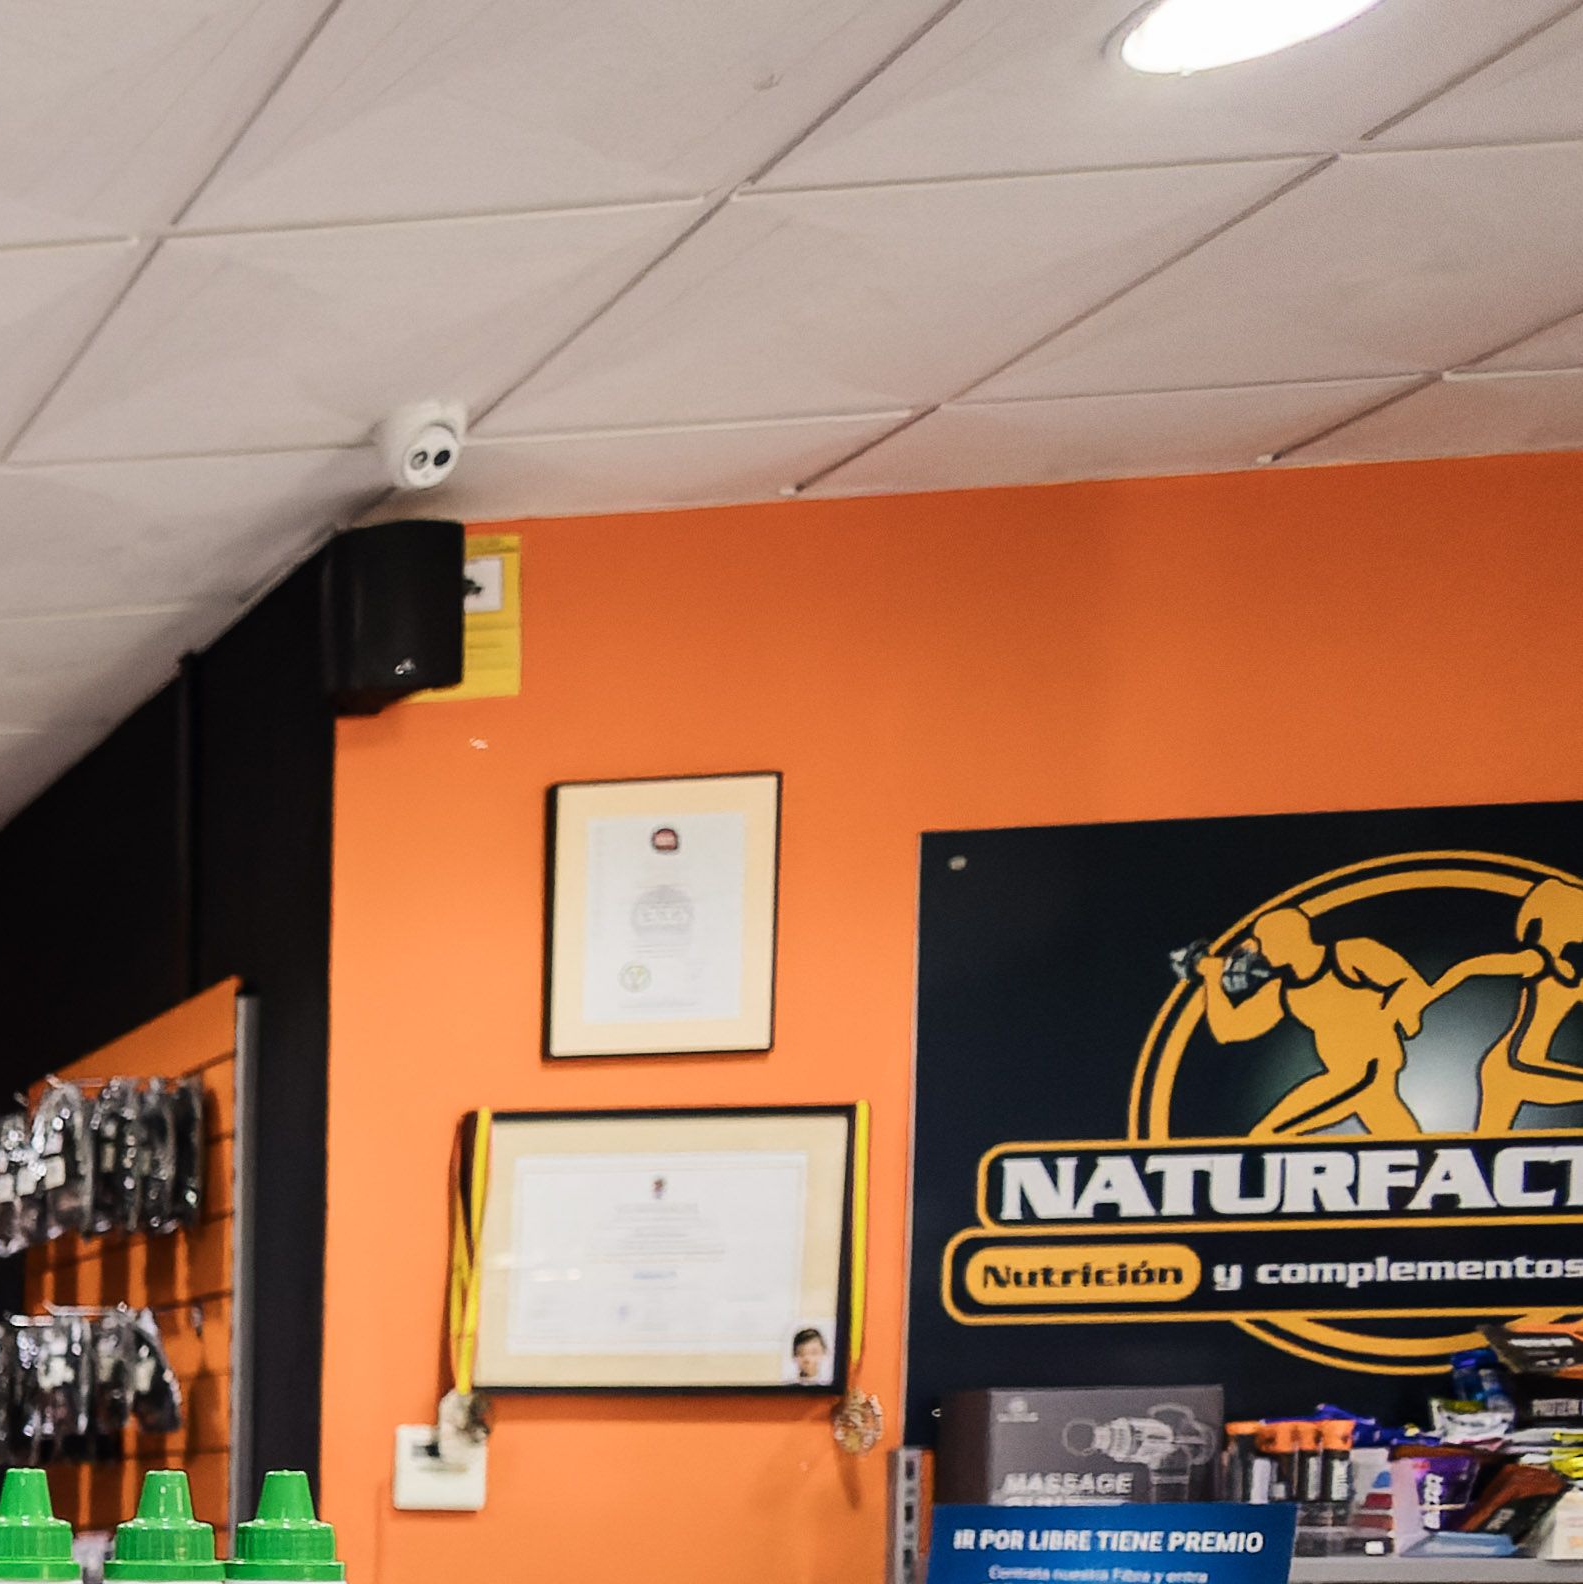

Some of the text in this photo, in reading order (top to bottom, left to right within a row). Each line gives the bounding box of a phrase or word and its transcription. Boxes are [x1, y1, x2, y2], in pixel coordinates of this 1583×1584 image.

[983, 1255, 1583, 1291] Nutrición y complementos
[1004, 1472, 1133, 1495] MASSAGE
[953, 1529, 1264, 1553] IR POR LIBRE TIENE PREMIO
